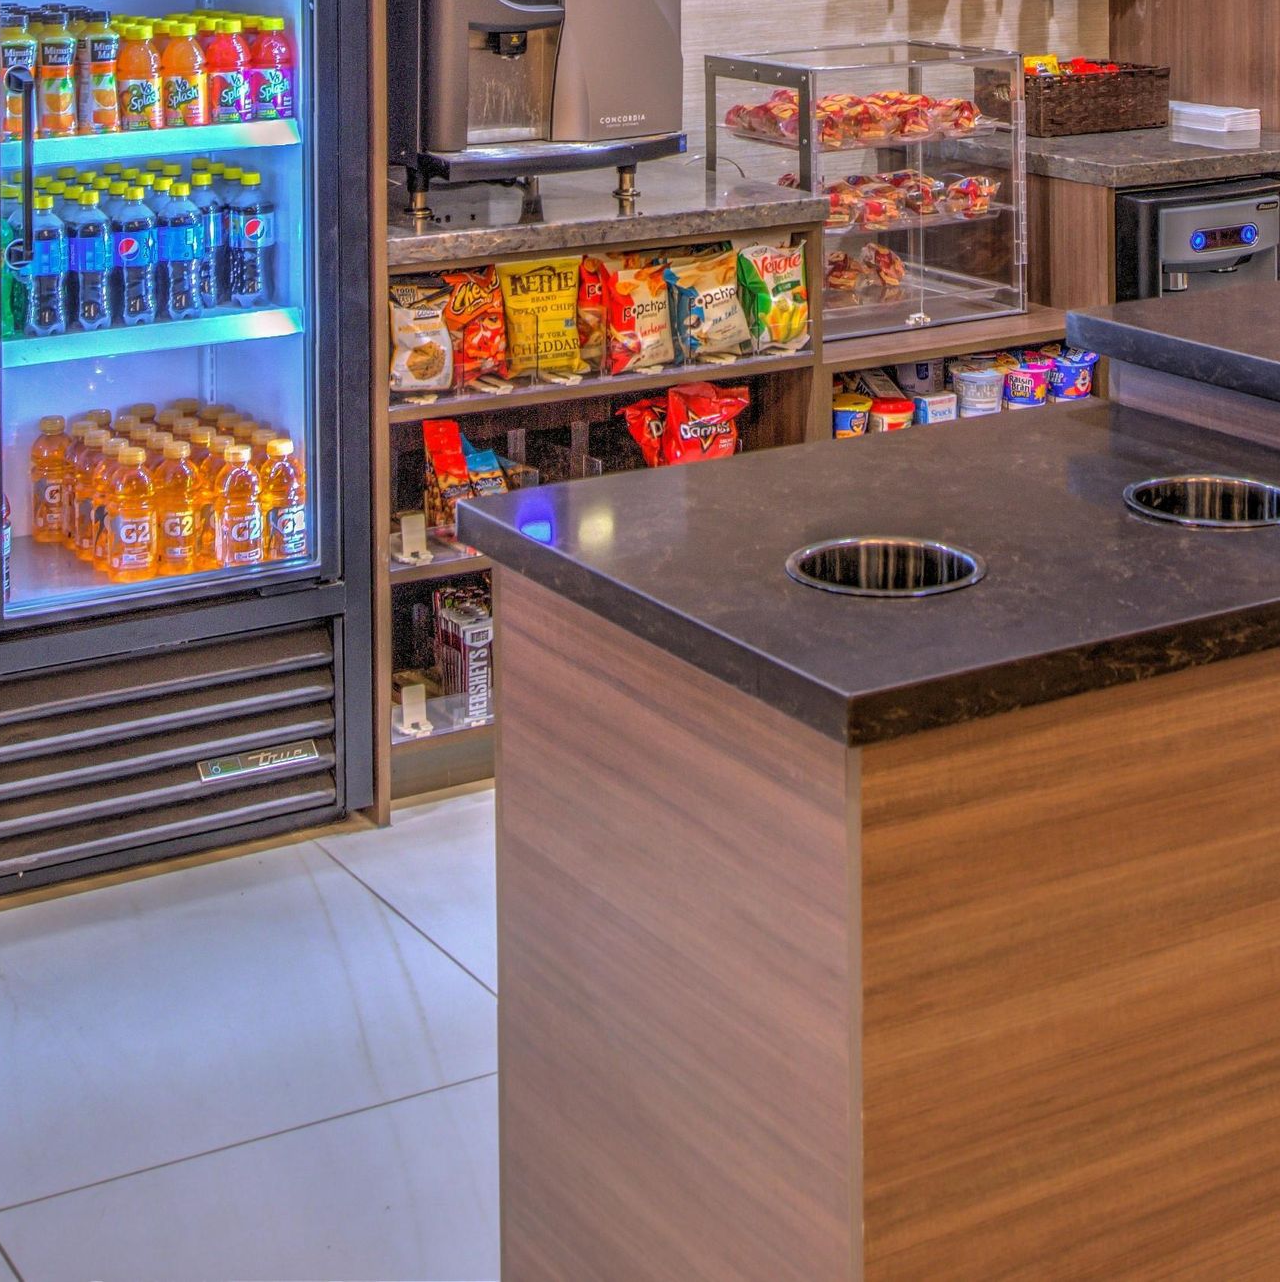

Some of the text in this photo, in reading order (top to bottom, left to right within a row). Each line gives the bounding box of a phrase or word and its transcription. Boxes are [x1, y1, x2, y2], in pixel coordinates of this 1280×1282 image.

[175, 78, 188, 91] V8
[231, 72, 242, 85] V8
[269, 71, 281, 84] V8
[140, 82, 153, 94] V8
[259, 79, 289, 99] Splash
[169, 85, 199, 107] Splash
[599, 114, 646, 125] CONCORDIA
[753, 251, 802, 275] Veggie
[509, 271, 576, 296] KETTLE
[530, 295, 557, 303] BRAND
[513, 303, 575, 316] POTATO CHIPS
[623, 299, 667, 321] popchips
[547, 331, 567, 339] YORK
[512, 338, 580, 356] CHEDDAR
[1008, 374, 1033, 386] Raisin
[1011, 382, 1030, 392] Bran
[120, 519, 150, 544] G2
[164, 515, 192, 537] G2
[231, 517, 261, 540] G2
[468, 643, 489, 722] HERSHEY'S
